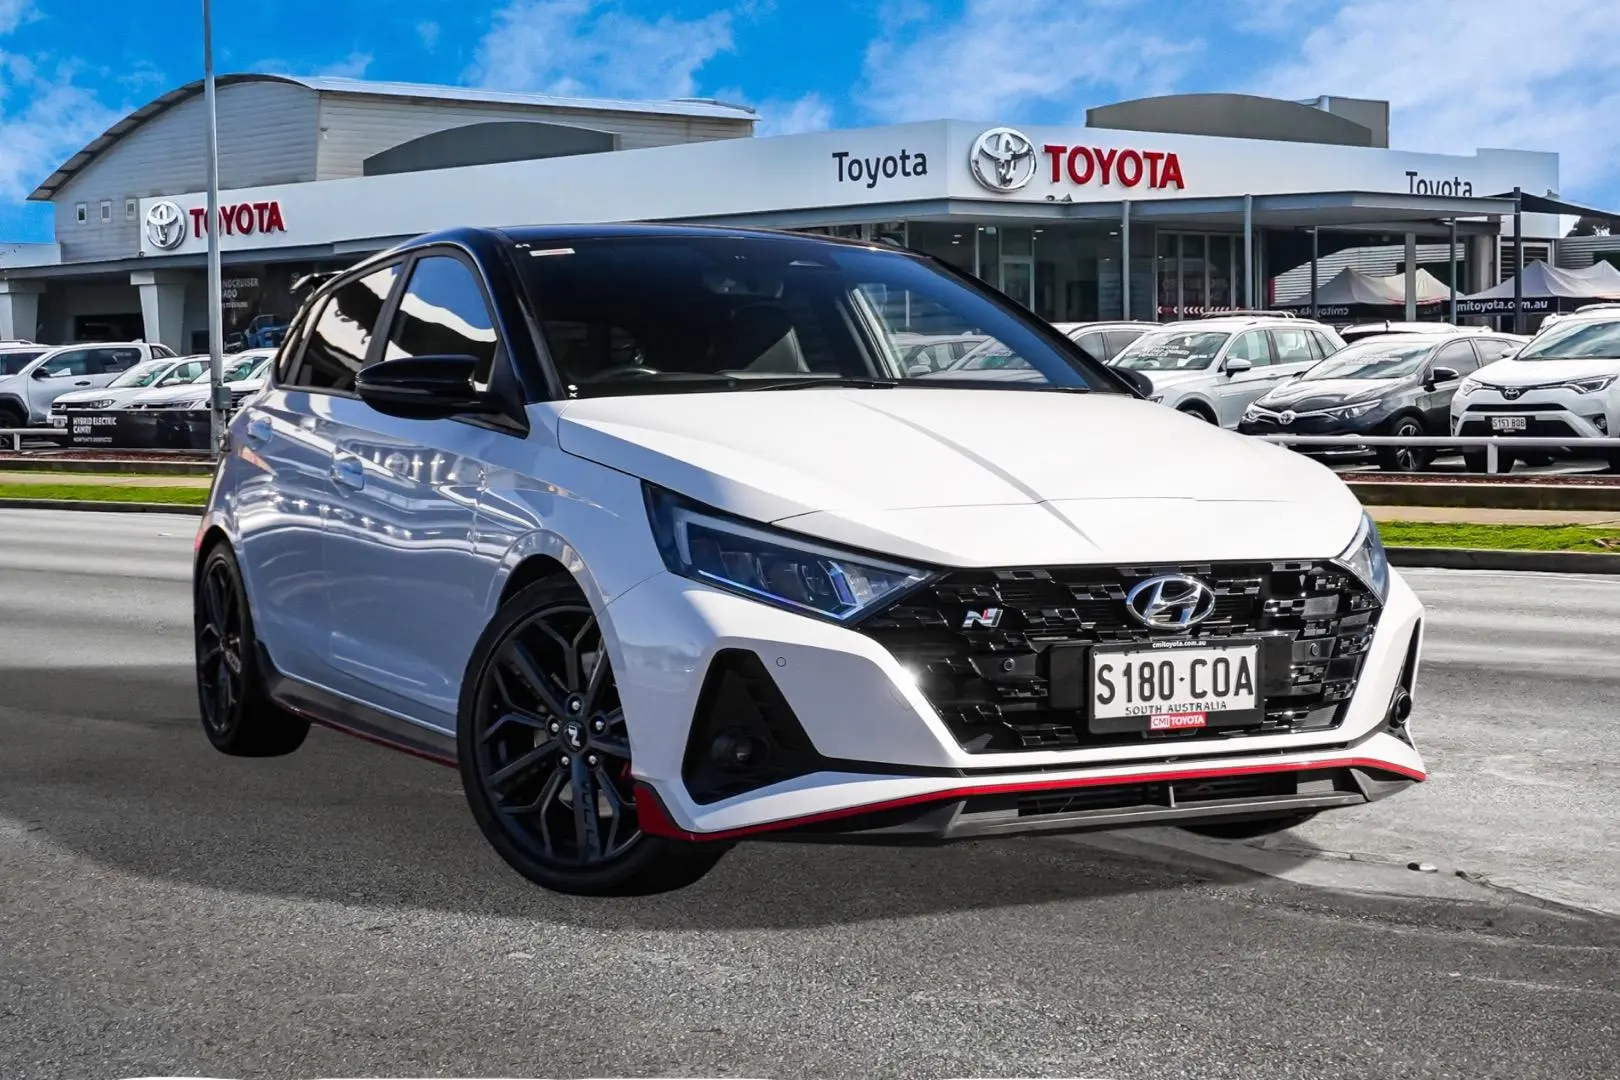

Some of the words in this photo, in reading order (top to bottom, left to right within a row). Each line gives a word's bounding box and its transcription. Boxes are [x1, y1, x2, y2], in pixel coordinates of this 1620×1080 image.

[832, 149, 927, 188] Toyota
[1044, 144, 1184, 189] TOYOTA
[1457, 300, 1548, 312] mitoyota.cm.au
[1125, 704, 1162, 716] SOUTH
[1168, 701, 1227, 713] AUSTRALIA
[1152, 718, 1169, 727] CMI
[1170, 715, 1206, 726] TOYOTA
